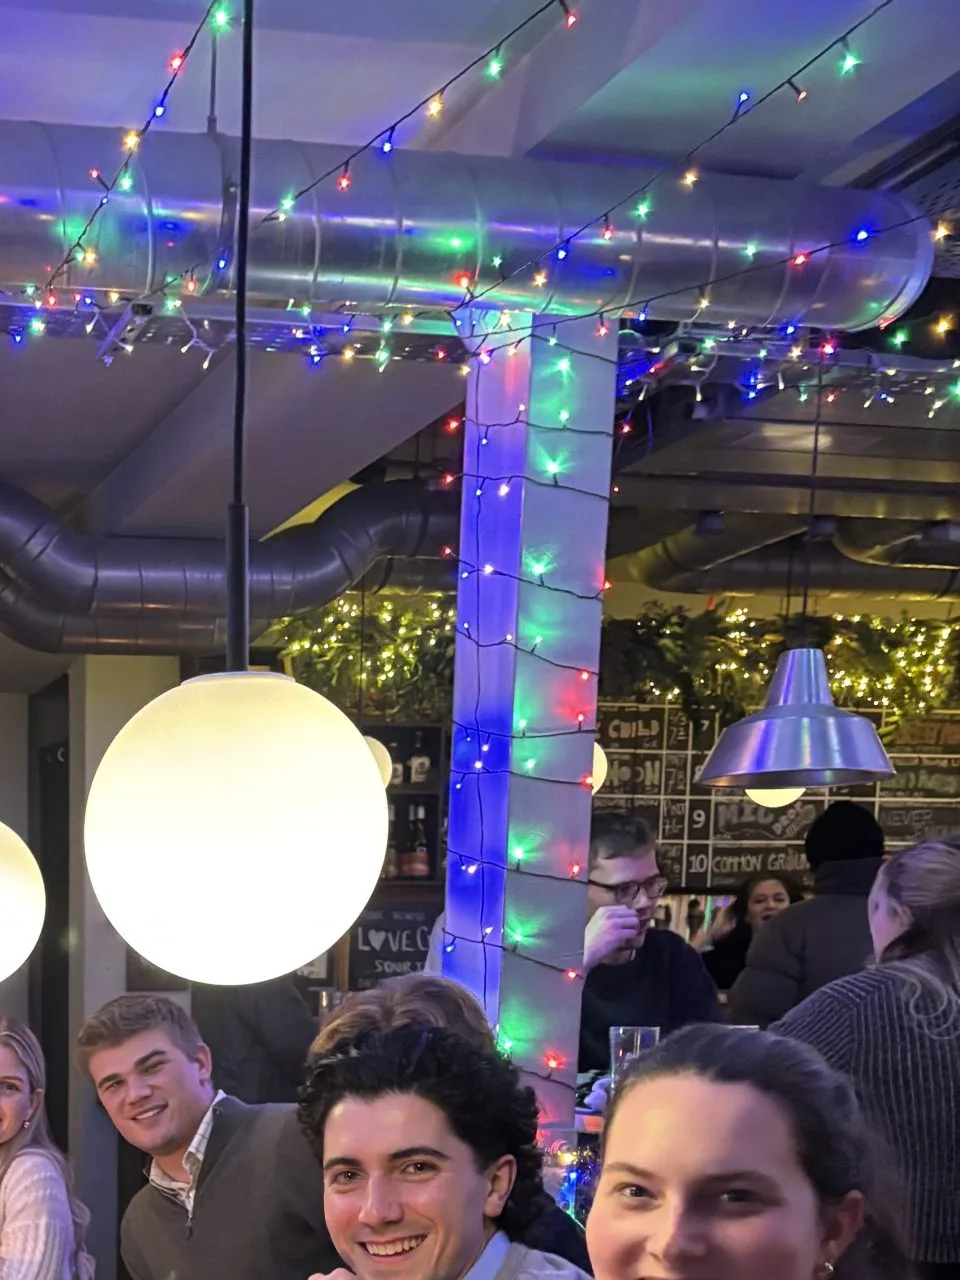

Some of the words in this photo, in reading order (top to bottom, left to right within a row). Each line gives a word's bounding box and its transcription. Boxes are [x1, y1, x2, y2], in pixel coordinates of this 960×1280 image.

[608, 719, 660, 738] CHILD
[692, 809, 706, 829] 9
[689, 854, 708, 873] 10
[711, 853, 762, 873] COMMON
[374, 959, 413, 973] SOUR
